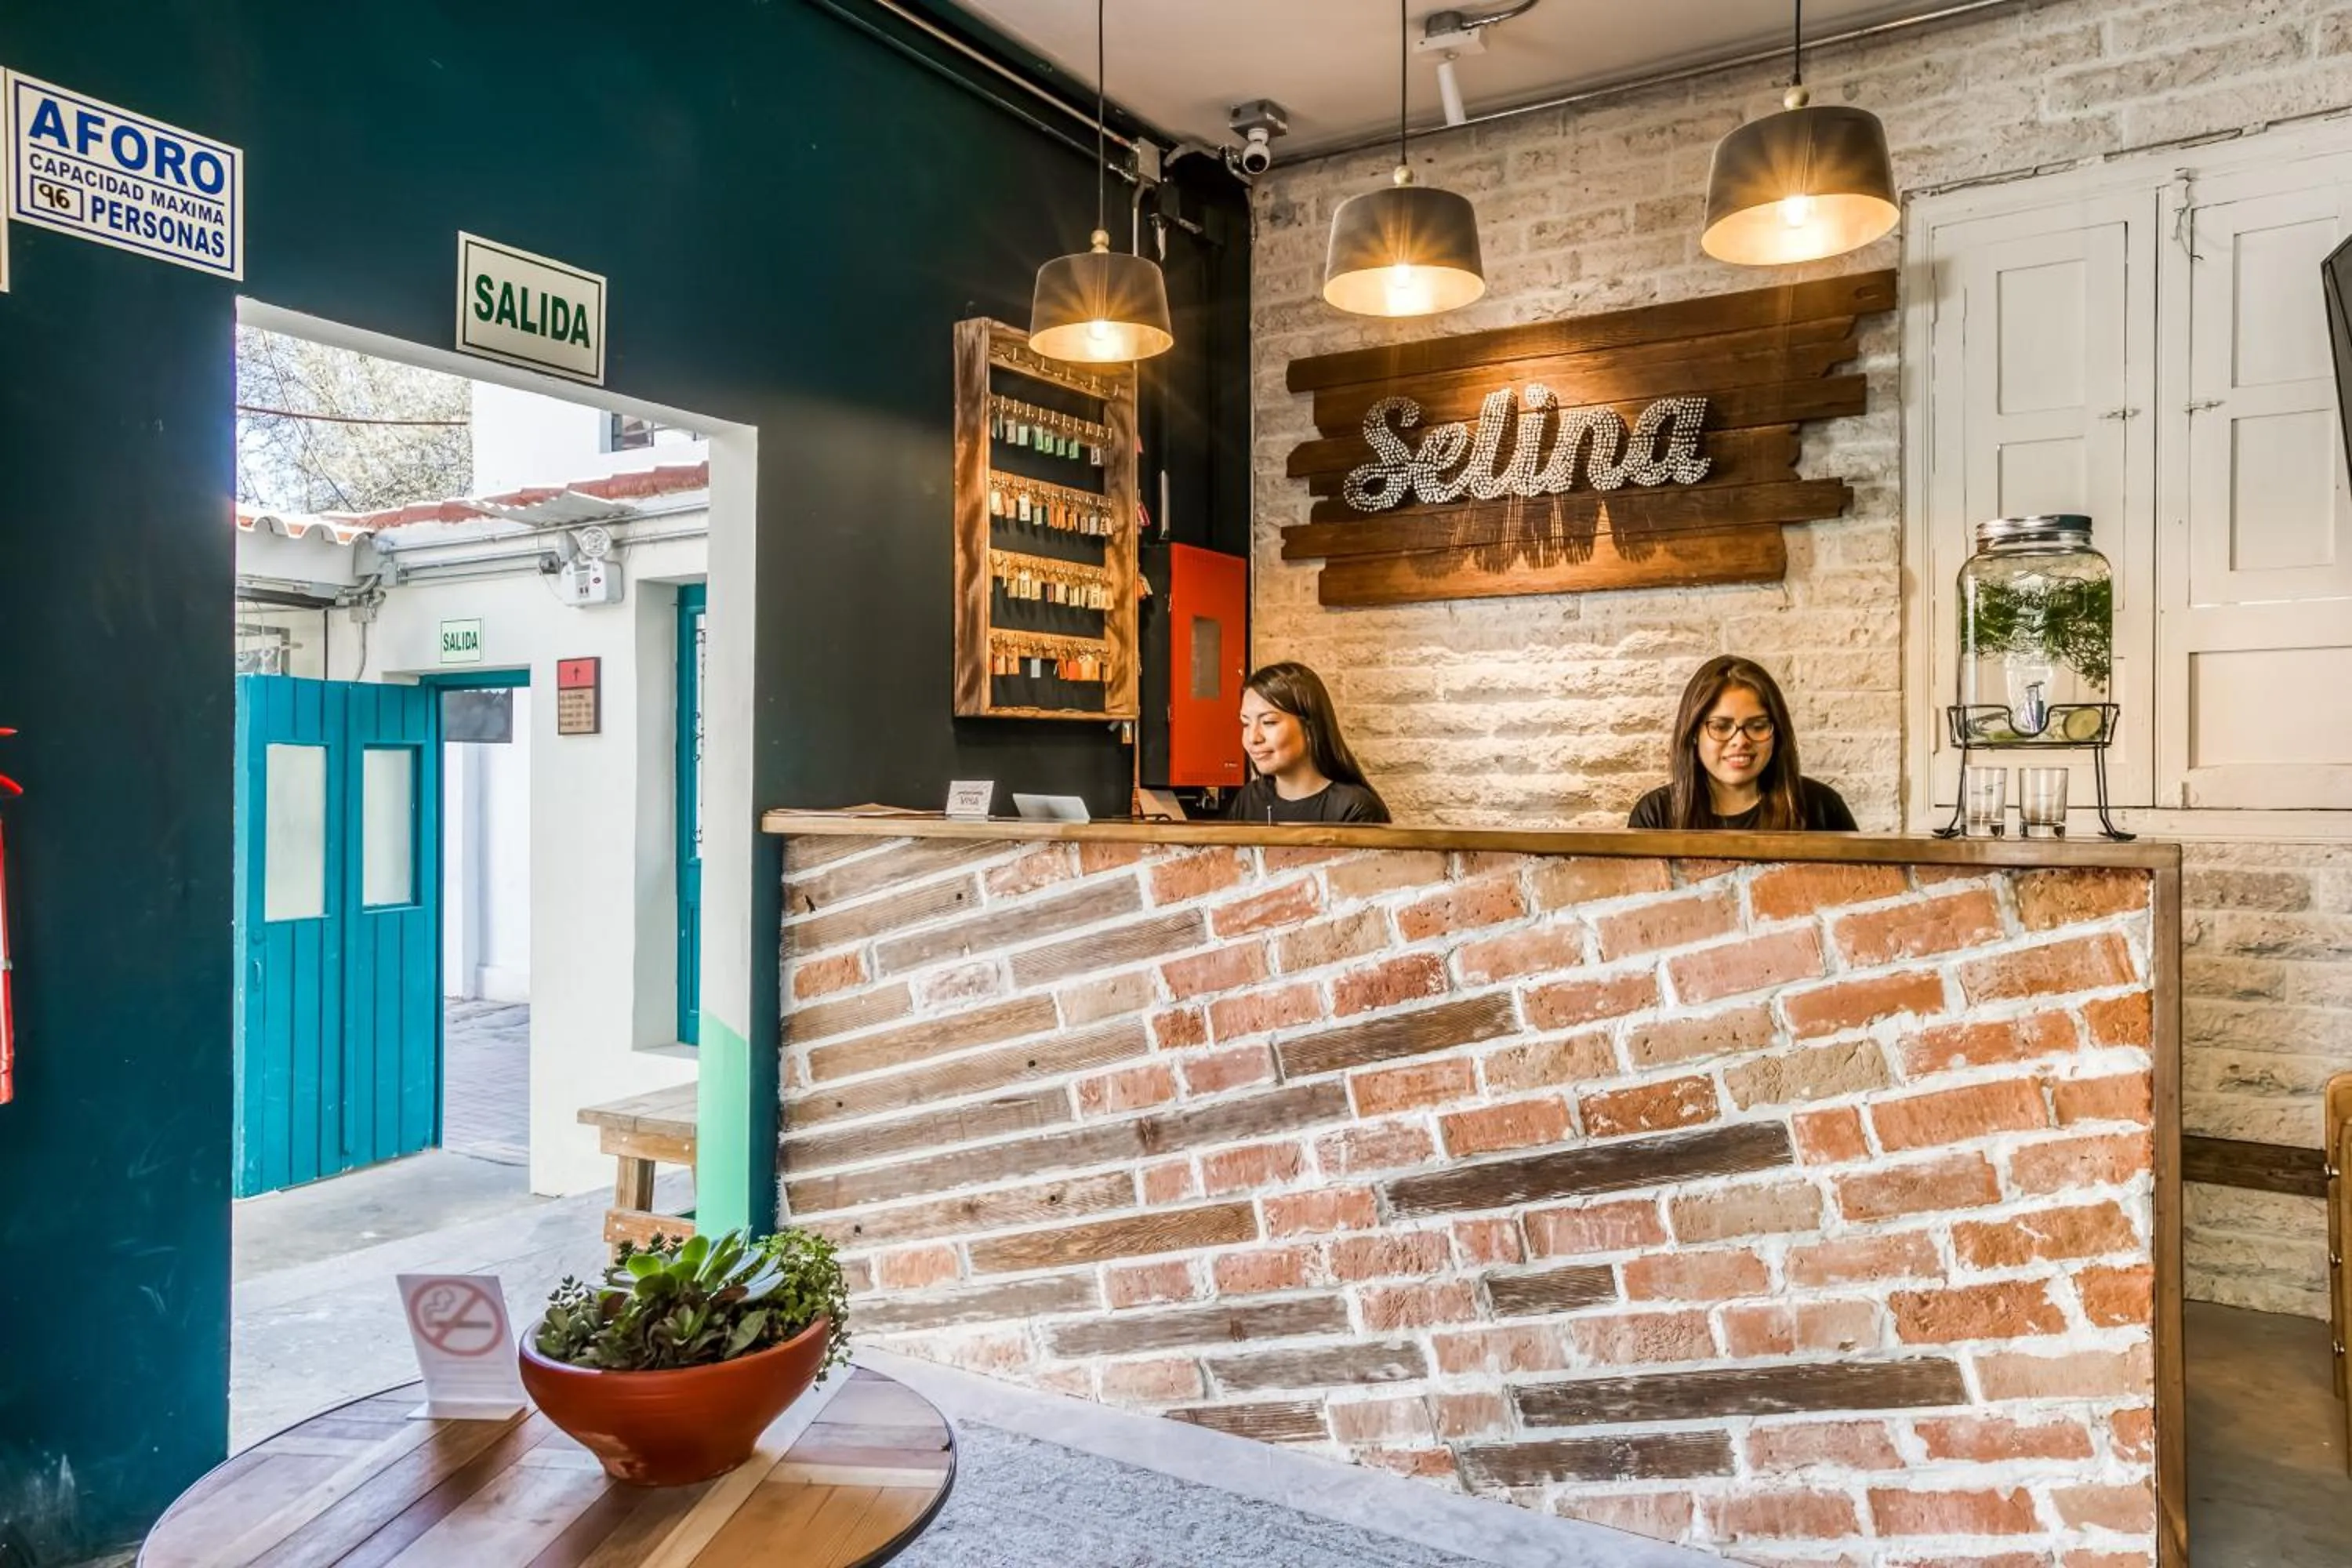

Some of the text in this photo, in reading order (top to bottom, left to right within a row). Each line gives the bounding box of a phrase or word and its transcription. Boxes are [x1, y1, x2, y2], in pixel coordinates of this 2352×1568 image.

[29, 98, 225, 195] AFORO
[29, 153, 225, 226] CAPACIDAD MAXIMA
[38, 183, 225, 258] 96 PERSONAS
[474, 274, 590, 349] SALIDA
[1342, 383, 1712, 513] Selina
[443, 631, 479, 652] SALIDA
